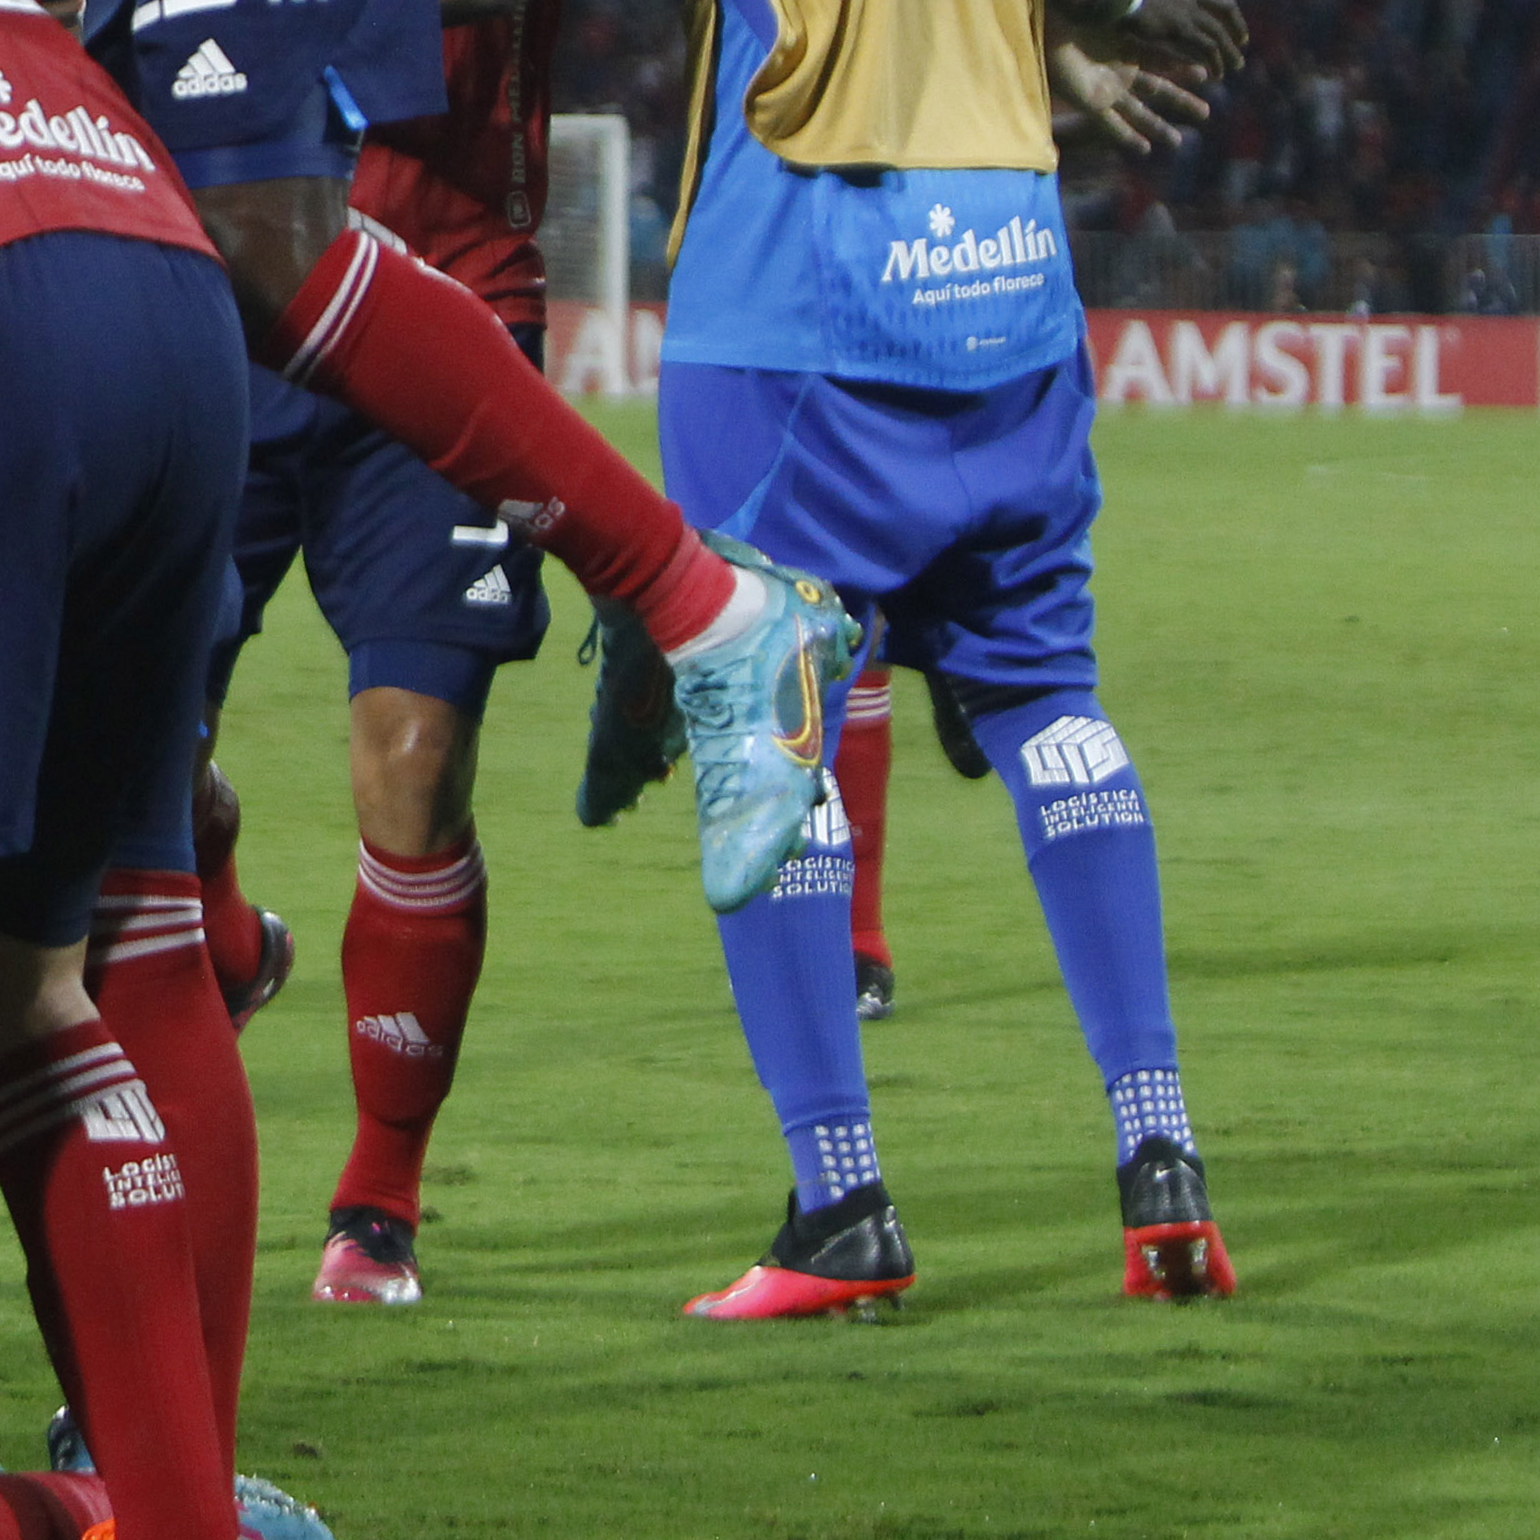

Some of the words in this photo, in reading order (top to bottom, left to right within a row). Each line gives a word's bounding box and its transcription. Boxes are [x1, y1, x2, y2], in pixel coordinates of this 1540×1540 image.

[172, 70, 248, 100] adidas
[34, 154, 82, 179] todo
[880, 214, 1058, 283] Medellín
[912, 283, 951, 307] Aquí
[954, 279, 991, 298] todo
[992, 272, 1046, 294] florece
[1101, 317, 1464, 412] AMSTEL
